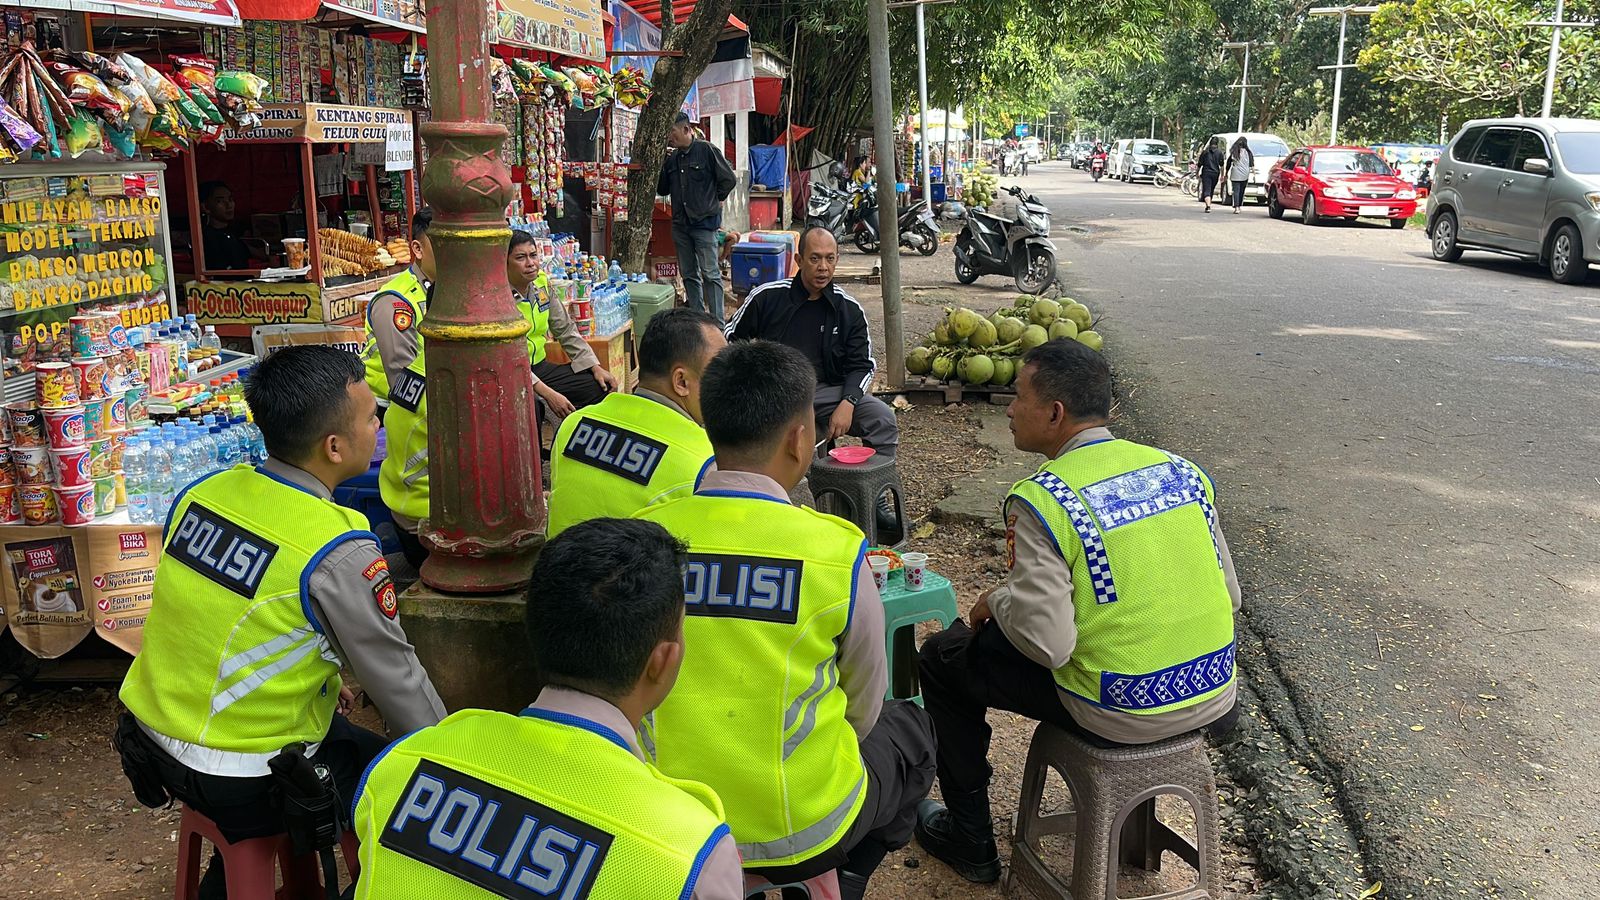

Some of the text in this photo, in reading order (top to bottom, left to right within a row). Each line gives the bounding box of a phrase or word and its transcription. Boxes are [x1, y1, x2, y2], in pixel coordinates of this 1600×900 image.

[317, 109, 372, 122] KENTANG
[246, 128, 293, 138] GULUNG
[323, 127, 387, 139] TELUR GULU
[389, 130, 411, 142] POP ICE
[387, 150, 413, 162] BLENDER
[106, 197, 161, 217] BAKSO
[6, 218, 156, 253] MODEL TEKWAN
[9, 248, 155, 282] BAKSO MERCON
[13, 274, 153, 311] BAKSO DAGING
[188, 289, 309, 321] k-Otak Singapur
[330, 298, 358, 320] KENT
[20, 304, 170, 345] POP ENDER
[568, 423, 660, 478] POLISI
[1100, 489, 1193, 527] POLISI
[120, 533, 144, 541] TORA
[123, 540, 145, 548] BIKA
[27, 549, 53, 559] TORA
[172, 510, 270, 588] POLISI
[31, 557, 54, 567] BIKA
[109, 573, 155, 588] Nyokelat Abi
[684, 562, 797, 612] OLISI
[16, 613, 38, 622] Perfect
[66, 614, 84, 622] Mood
[392, 773, 600, 900] POLISI
